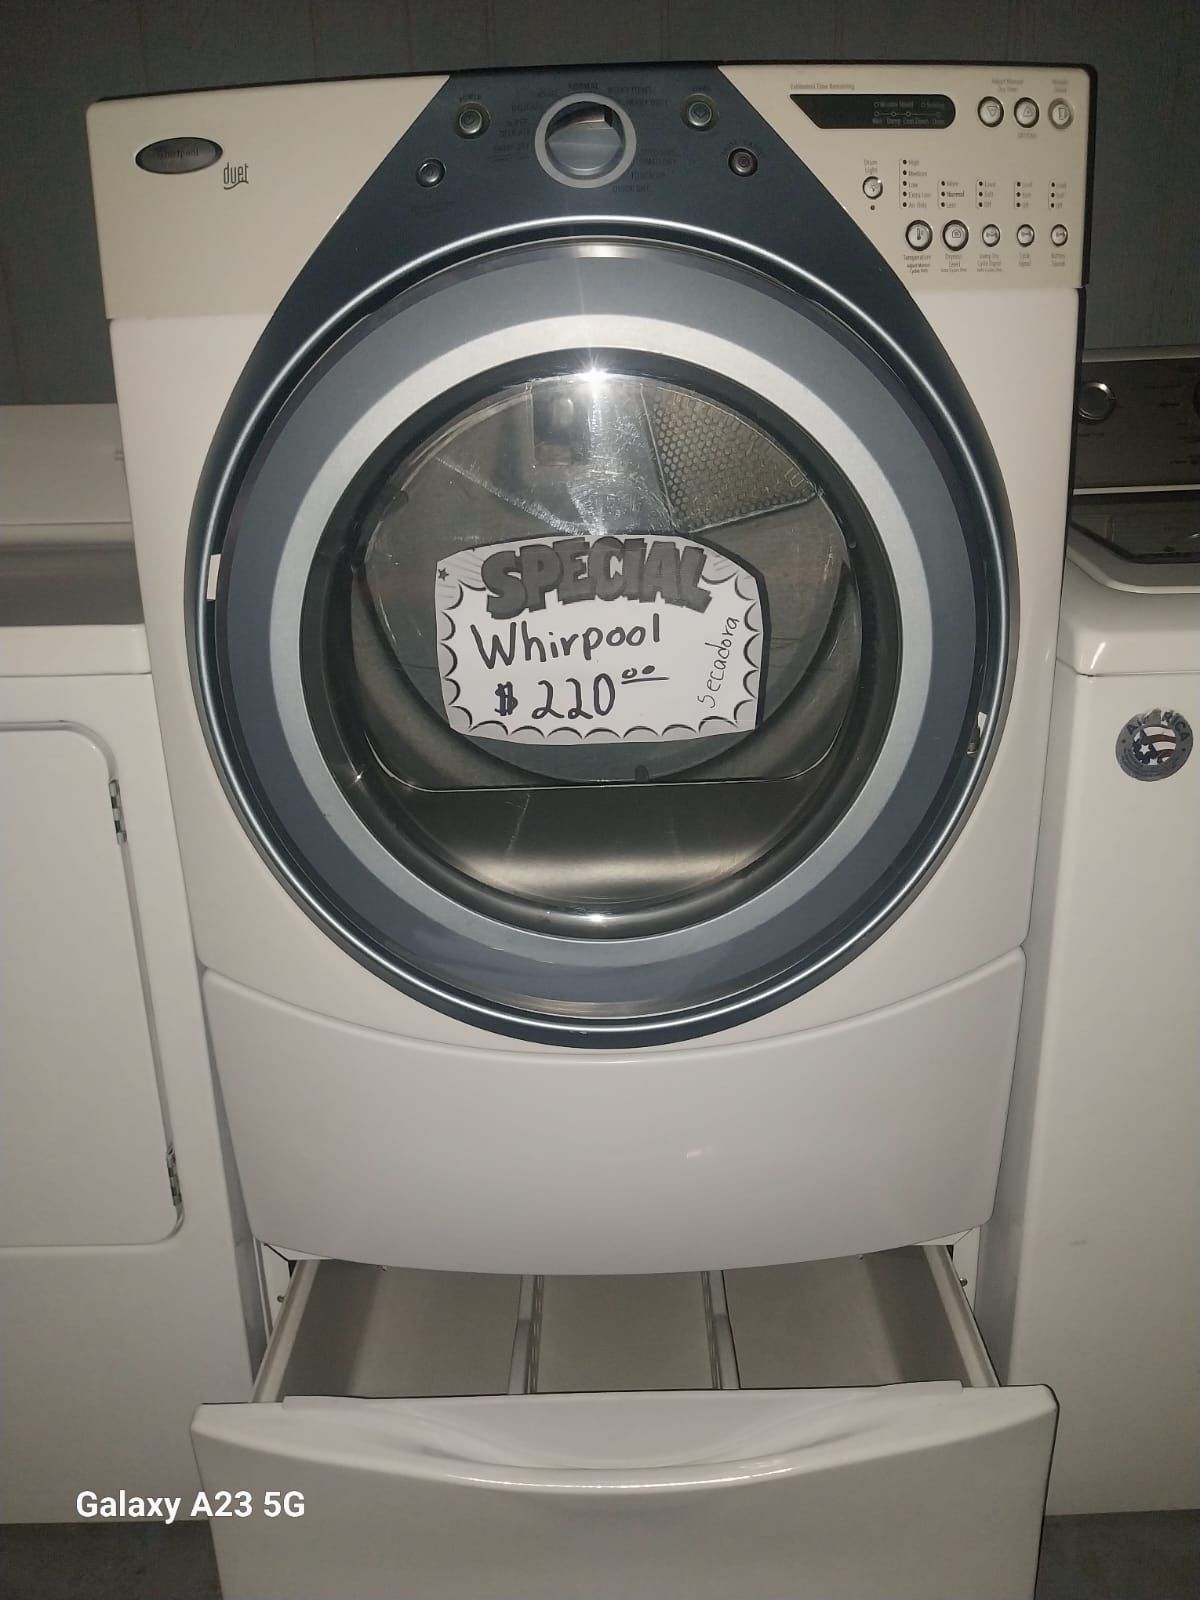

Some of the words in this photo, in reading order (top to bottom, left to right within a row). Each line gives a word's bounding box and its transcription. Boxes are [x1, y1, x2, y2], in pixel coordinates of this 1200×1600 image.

[223, 162, 249, 190] duet
[481, 536, 712, 619] SPECIAL
[470, 613, 660, 669] Whirpool
